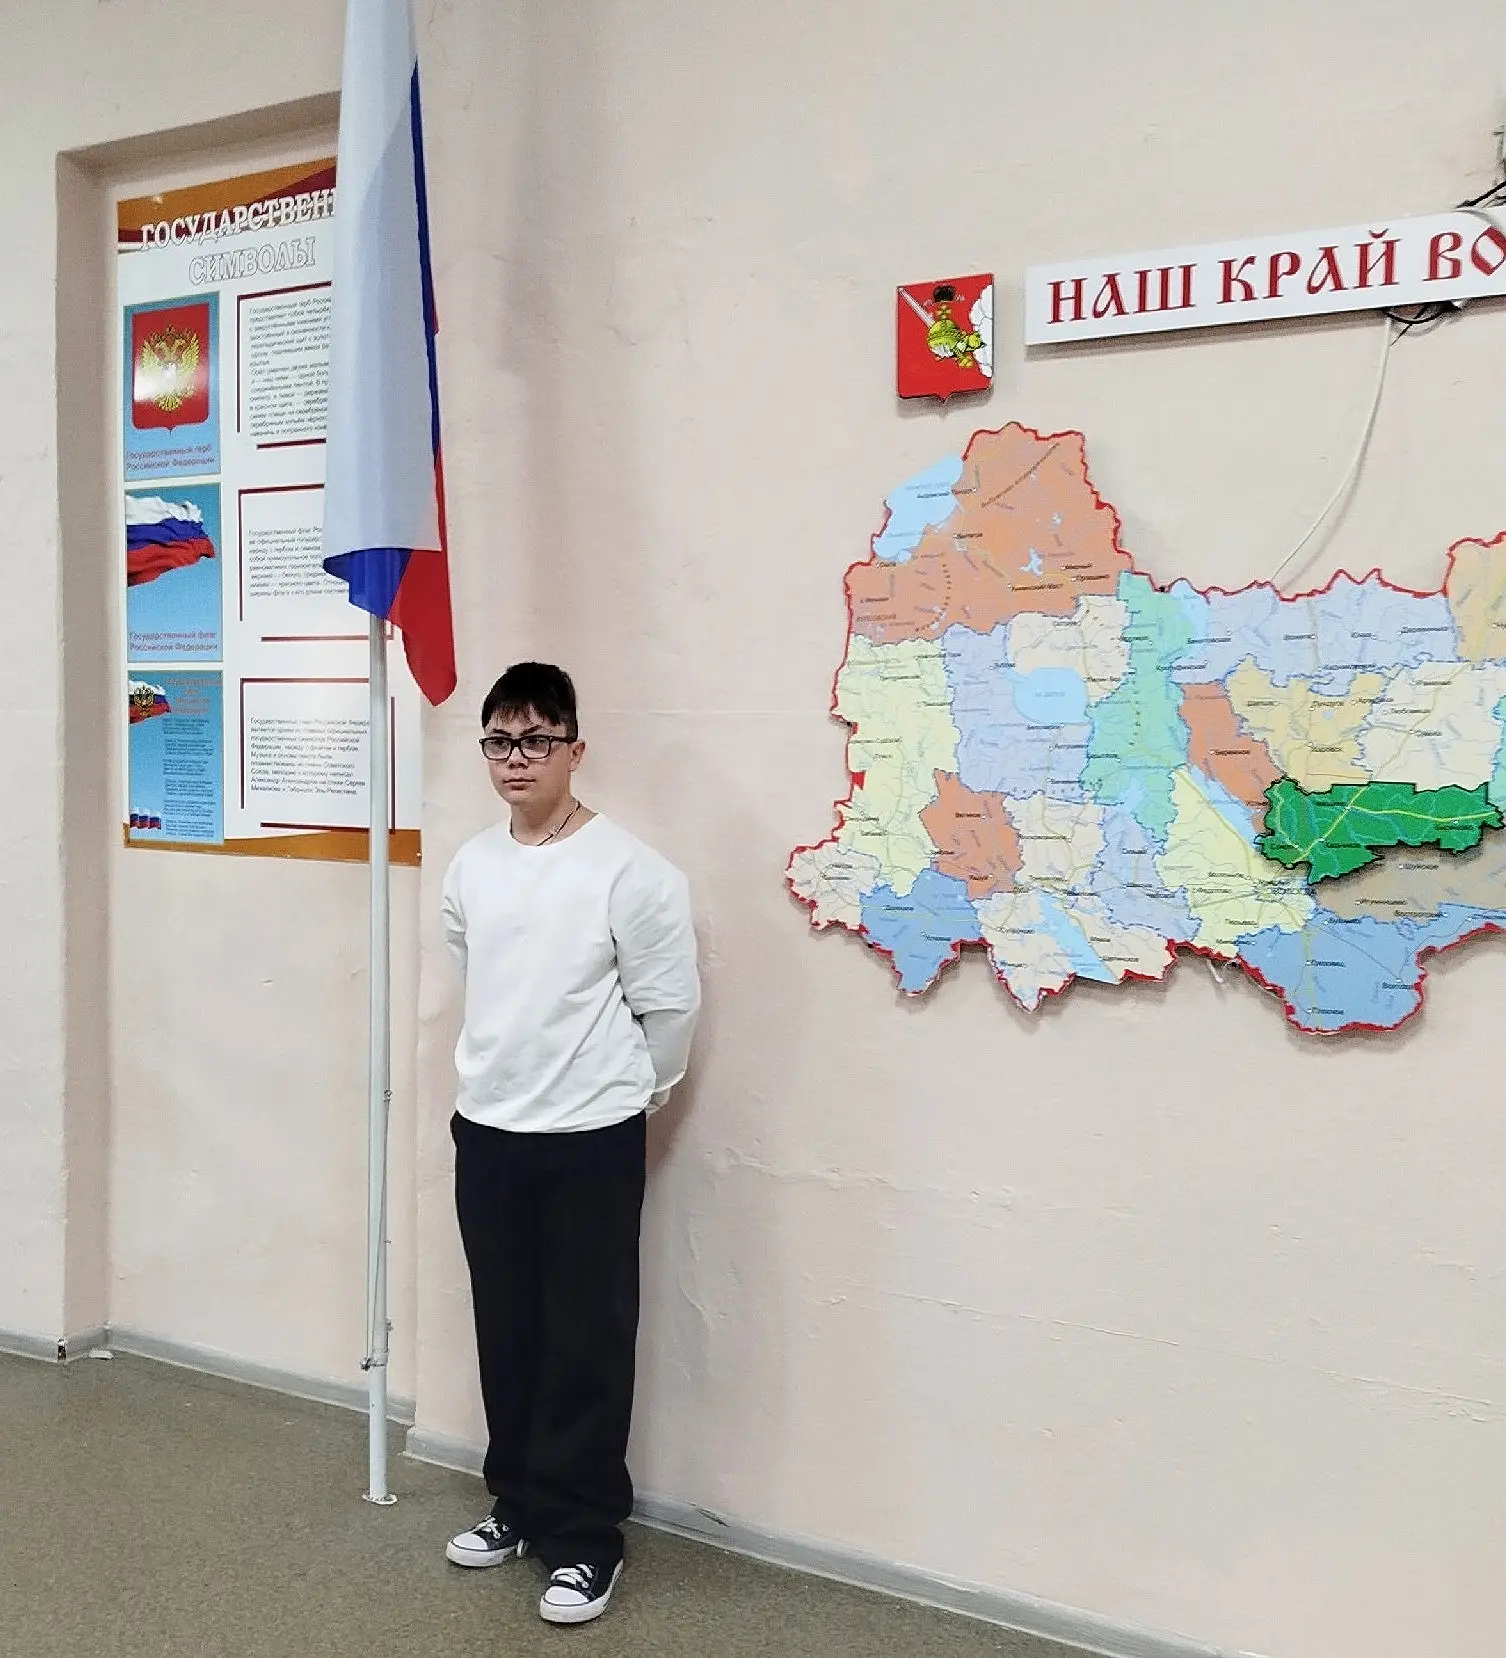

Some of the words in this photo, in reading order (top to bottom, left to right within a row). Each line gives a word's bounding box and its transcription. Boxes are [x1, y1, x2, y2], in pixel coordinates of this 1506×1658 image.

[188, 236, 317, 286] СИМВОЛЫ
[1046, 263, 1198, 325] НАШ
[1216, 227, 1402, 305] КРАЙ
[1422, 225, 1506, 282] ВО
